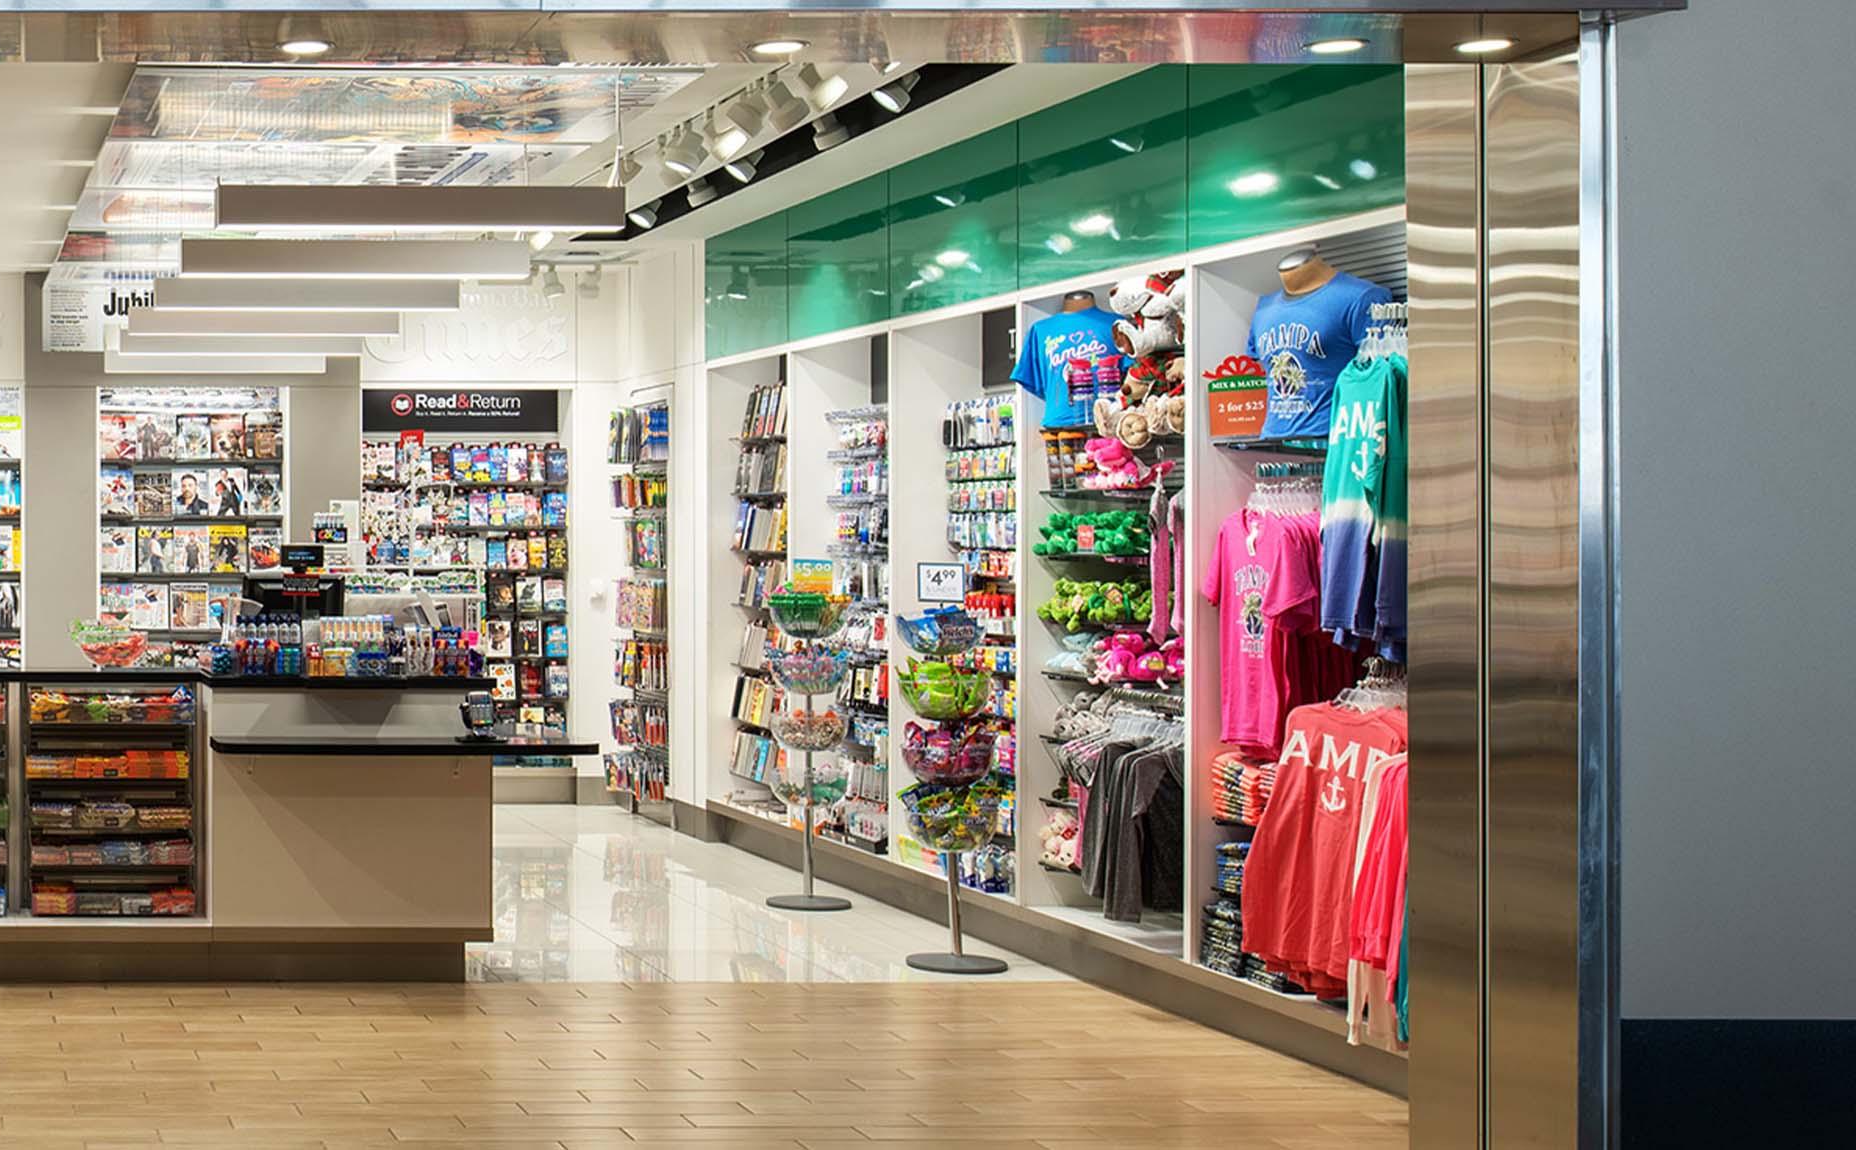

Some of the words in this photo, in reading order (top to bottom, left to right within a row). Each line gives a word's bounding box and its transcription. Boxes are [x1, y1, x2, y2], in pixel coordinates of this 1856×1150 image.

[1258, 322, 1327, 360] TAMPA
[1218, 403, 1225, 413] 2
[1227, 401, 1243, 412] for
[1245, 400, 1265, 410] $25
